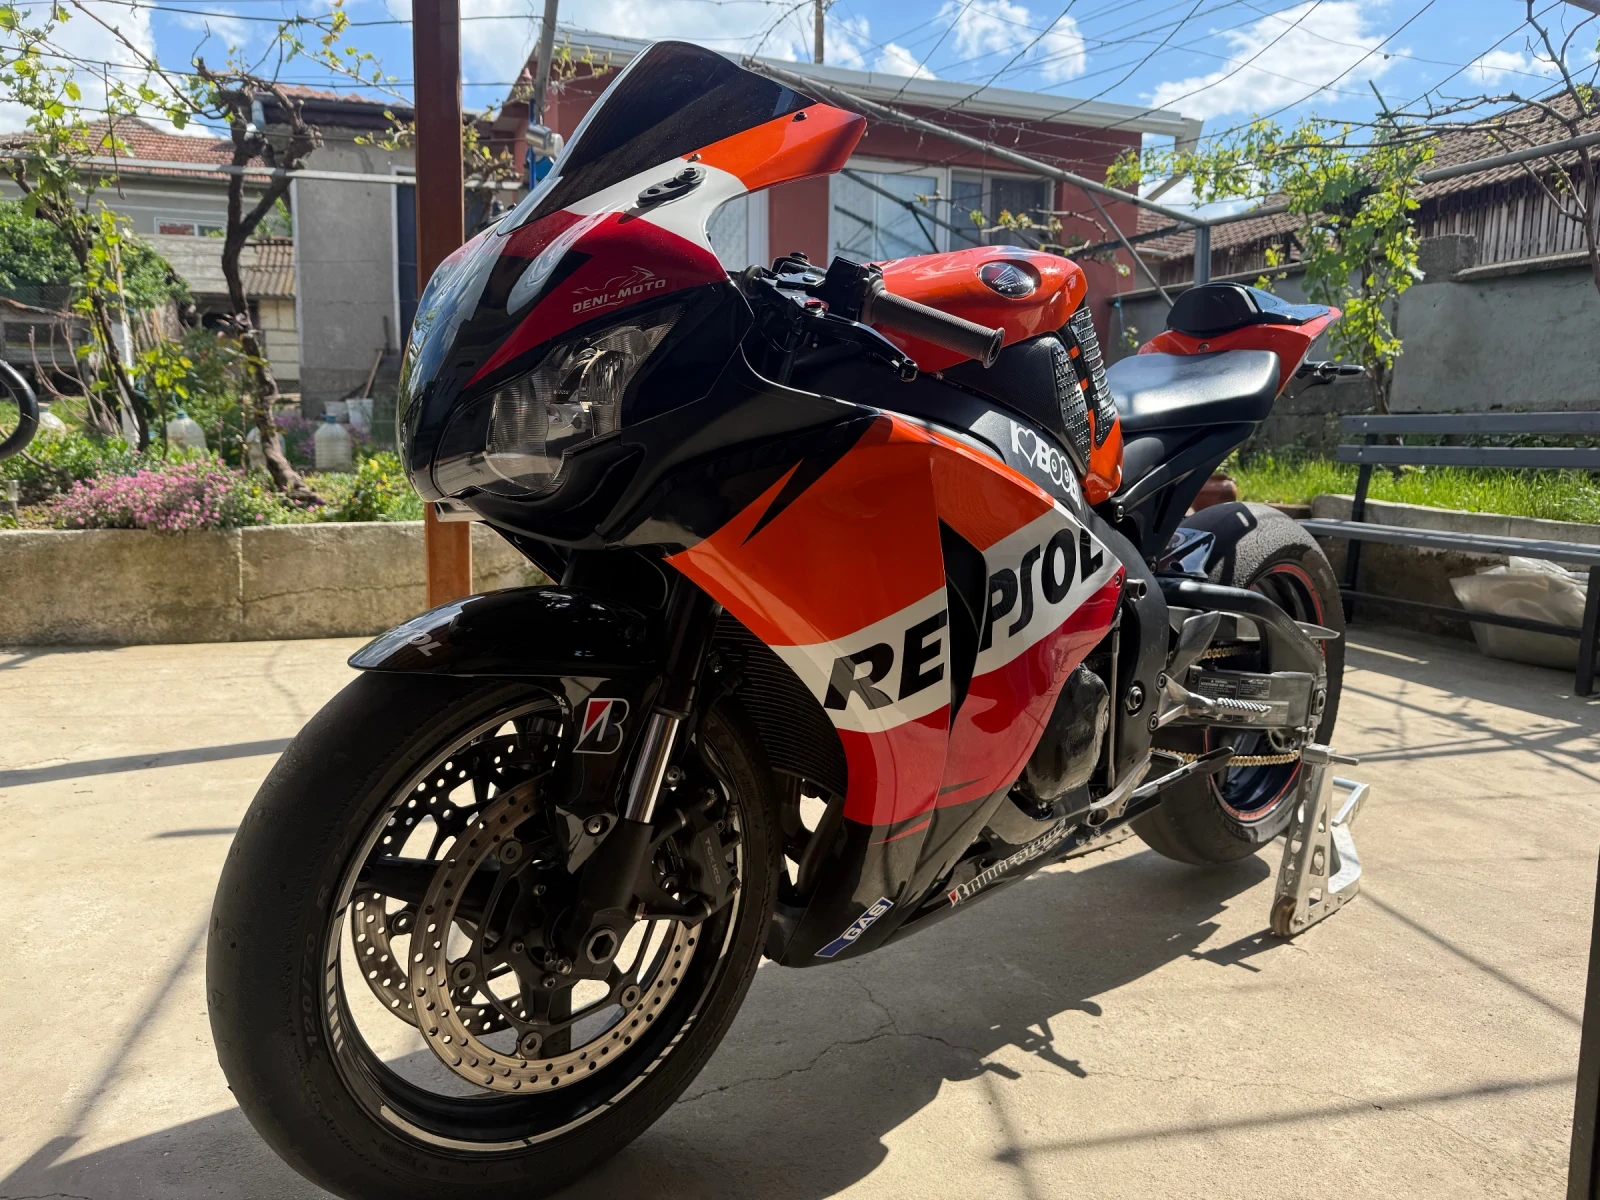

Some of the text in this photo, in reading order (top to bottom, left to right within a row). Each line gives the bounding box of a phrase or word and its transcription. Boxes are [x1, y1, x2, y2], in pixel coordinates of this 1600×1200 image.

[572, 278, 666, 313] DENI-MOTO
[705, 836, 721, 885] TOKICO
[842, 904, 888, 941] GAS
